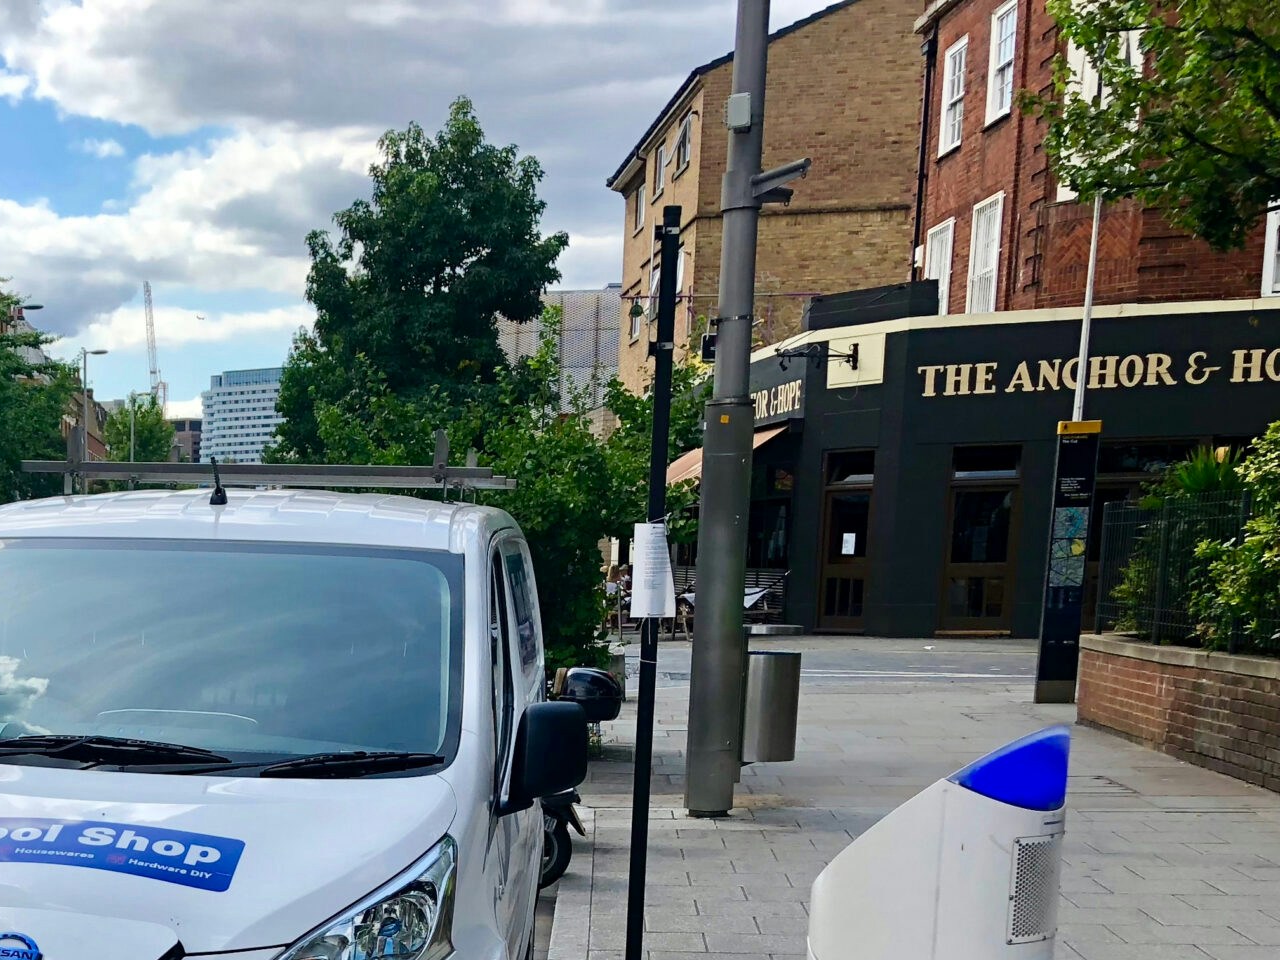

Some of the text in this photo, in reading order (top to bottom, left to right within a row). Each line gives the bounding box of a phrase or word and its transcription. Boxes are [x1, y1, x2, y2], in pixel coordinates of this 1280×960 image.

[917, 362, 998, 397] THE
[1004, 353, 1177, 394] ANCHOR
[1185, 351, 1222, 385] &
[777, 378, 803, 414] HOPE
[14, 846, 95, 860] Housewares
[77, 826, 222, 867] Shop
[128, 858, 213, 880] Hardware DIY
